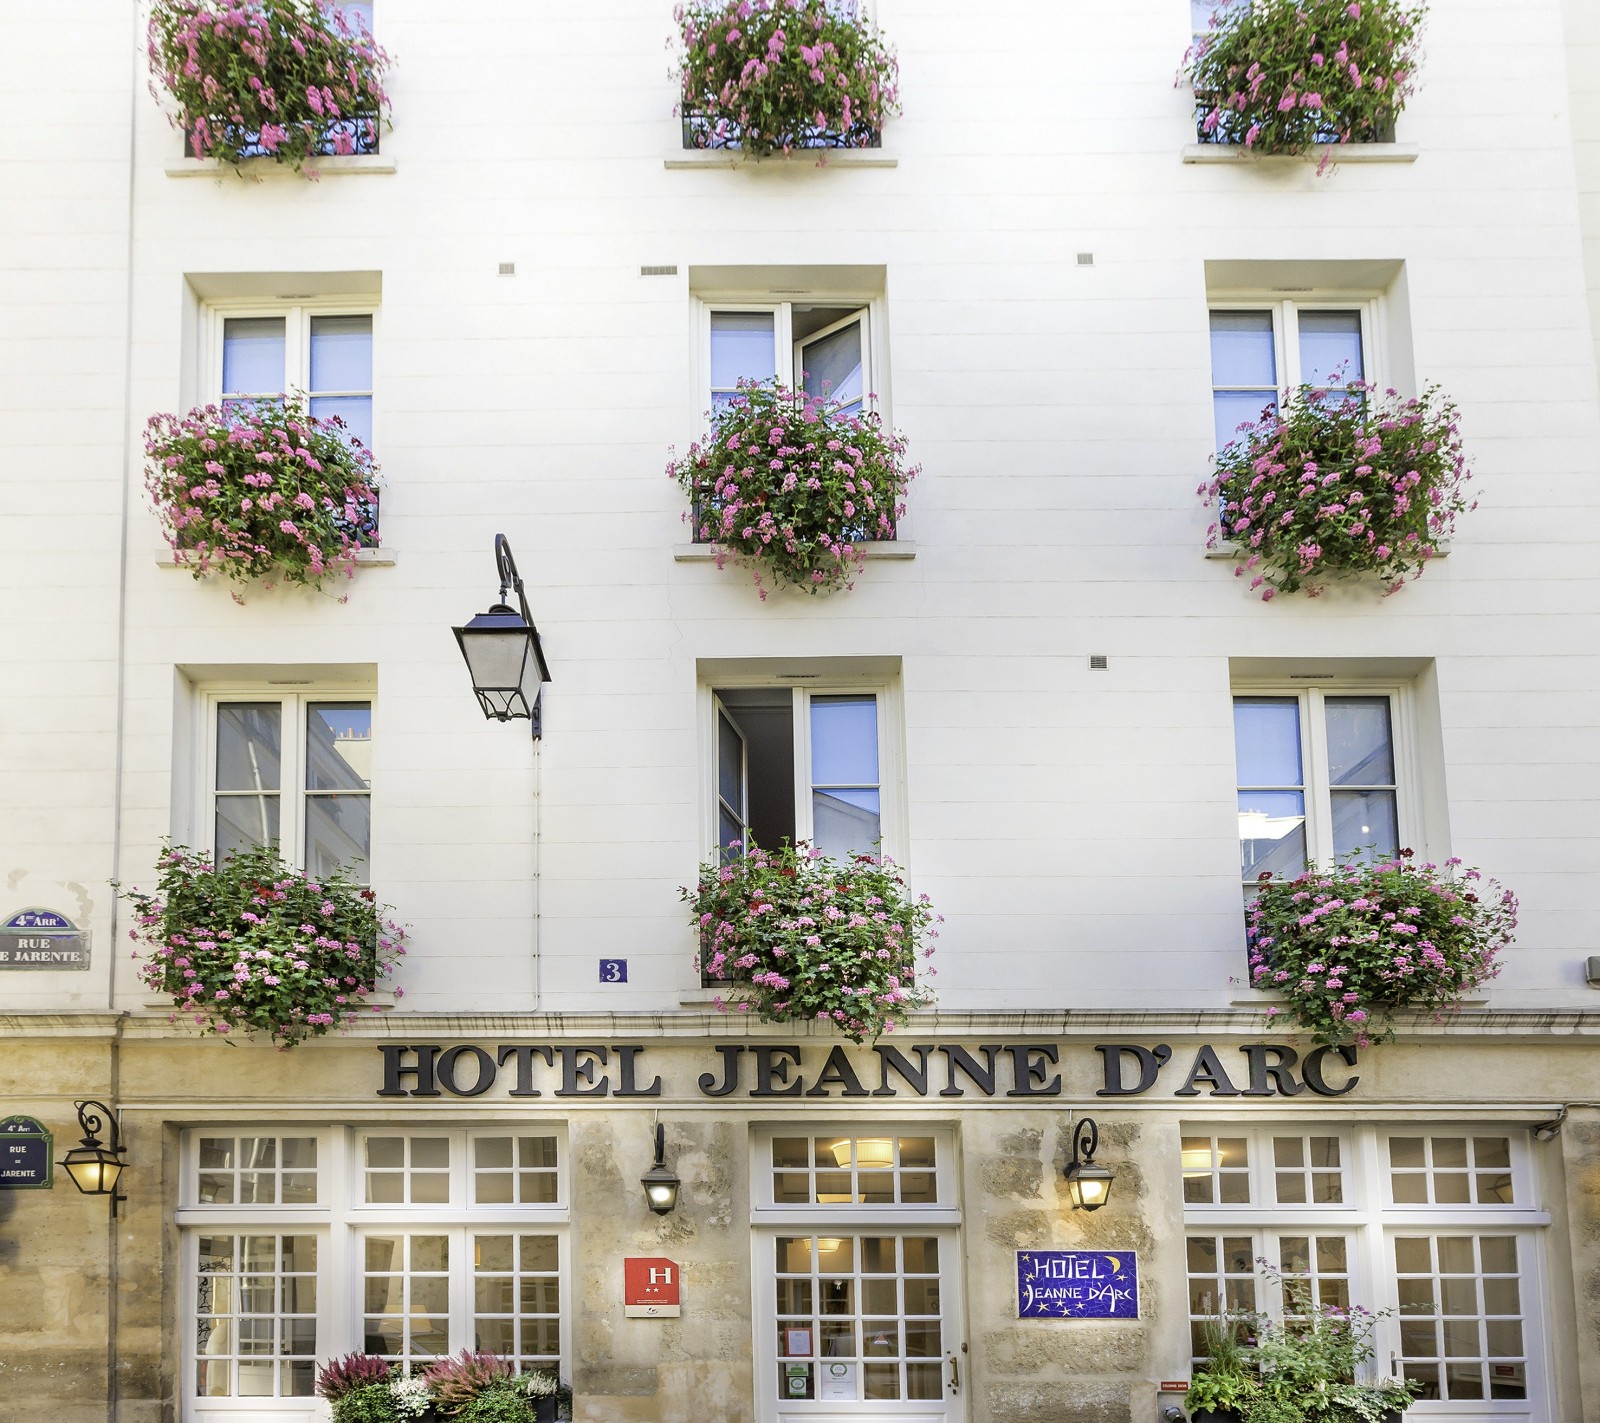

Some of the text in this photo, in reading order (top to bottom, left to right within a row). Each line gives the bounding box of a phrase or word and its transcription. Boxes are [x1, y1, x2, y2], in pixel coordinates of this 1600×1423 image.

[18, 939, 50, 949] RUE
[0, 951, 9, 962] E
[606, 962, 621, 982] 3
[377, 1043, 1360, 1097] HOTEL JEANNE D’ARC
[648, 1267, 674, 1285] H
[1034, 1254, 1105, 1279] HOTEL
